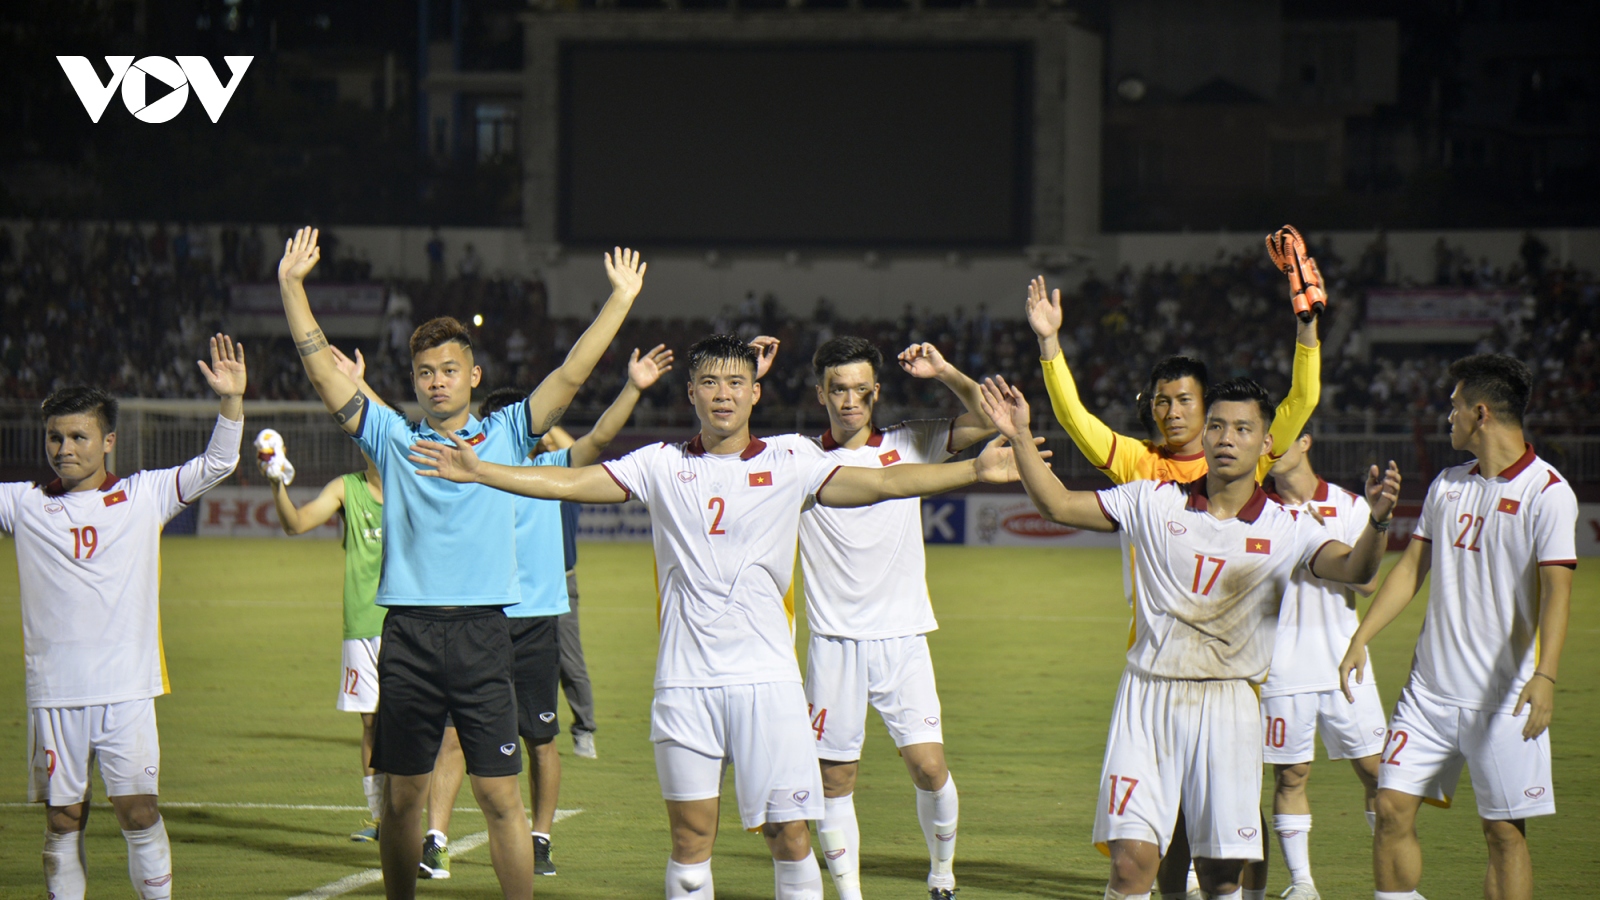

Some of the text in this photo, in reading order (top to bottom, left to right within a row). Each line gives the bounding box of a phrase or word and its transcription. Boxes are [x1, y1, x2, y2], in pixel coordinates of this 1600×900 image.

[708, 496, 726, 535] 2
[1453, 513, 1485, 552] 22
[69, 525, 98, 559] 19
[1191, 553, 1227, 596] 17
[344, 666, 359, 696] 12
[1265, 715, 1286, 748] 10
[1380, 729, 1409, 766] 22
[1108, 774, 1139, 816] 17
